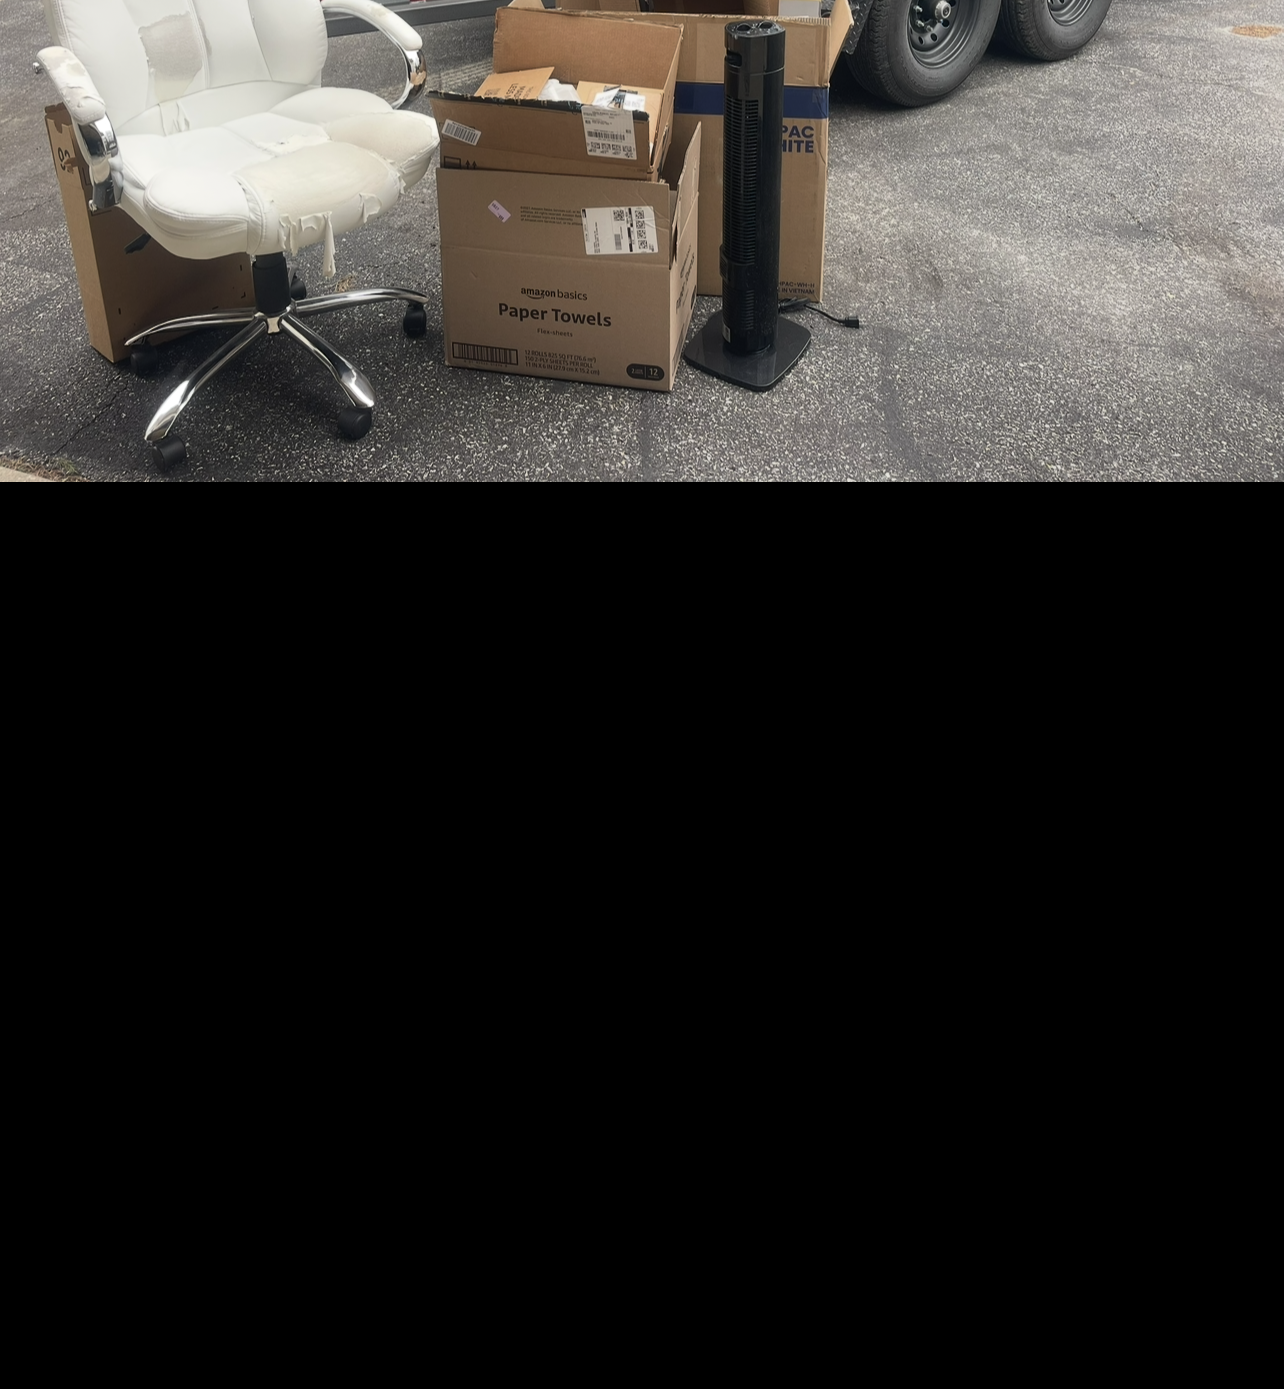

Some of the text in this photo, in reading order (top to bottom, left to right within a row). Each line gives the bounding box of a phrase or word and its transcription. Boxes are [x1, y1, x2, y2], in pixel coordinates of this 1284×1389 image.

[498, 302, 612, 327] Paper Towels
[537, 328, 573, 338] Flex-sheets
[531, 350, 548, 358] ROLLS
[549, 358, 569, 366] SHEETS
[649, 367, 658, 376] 12
